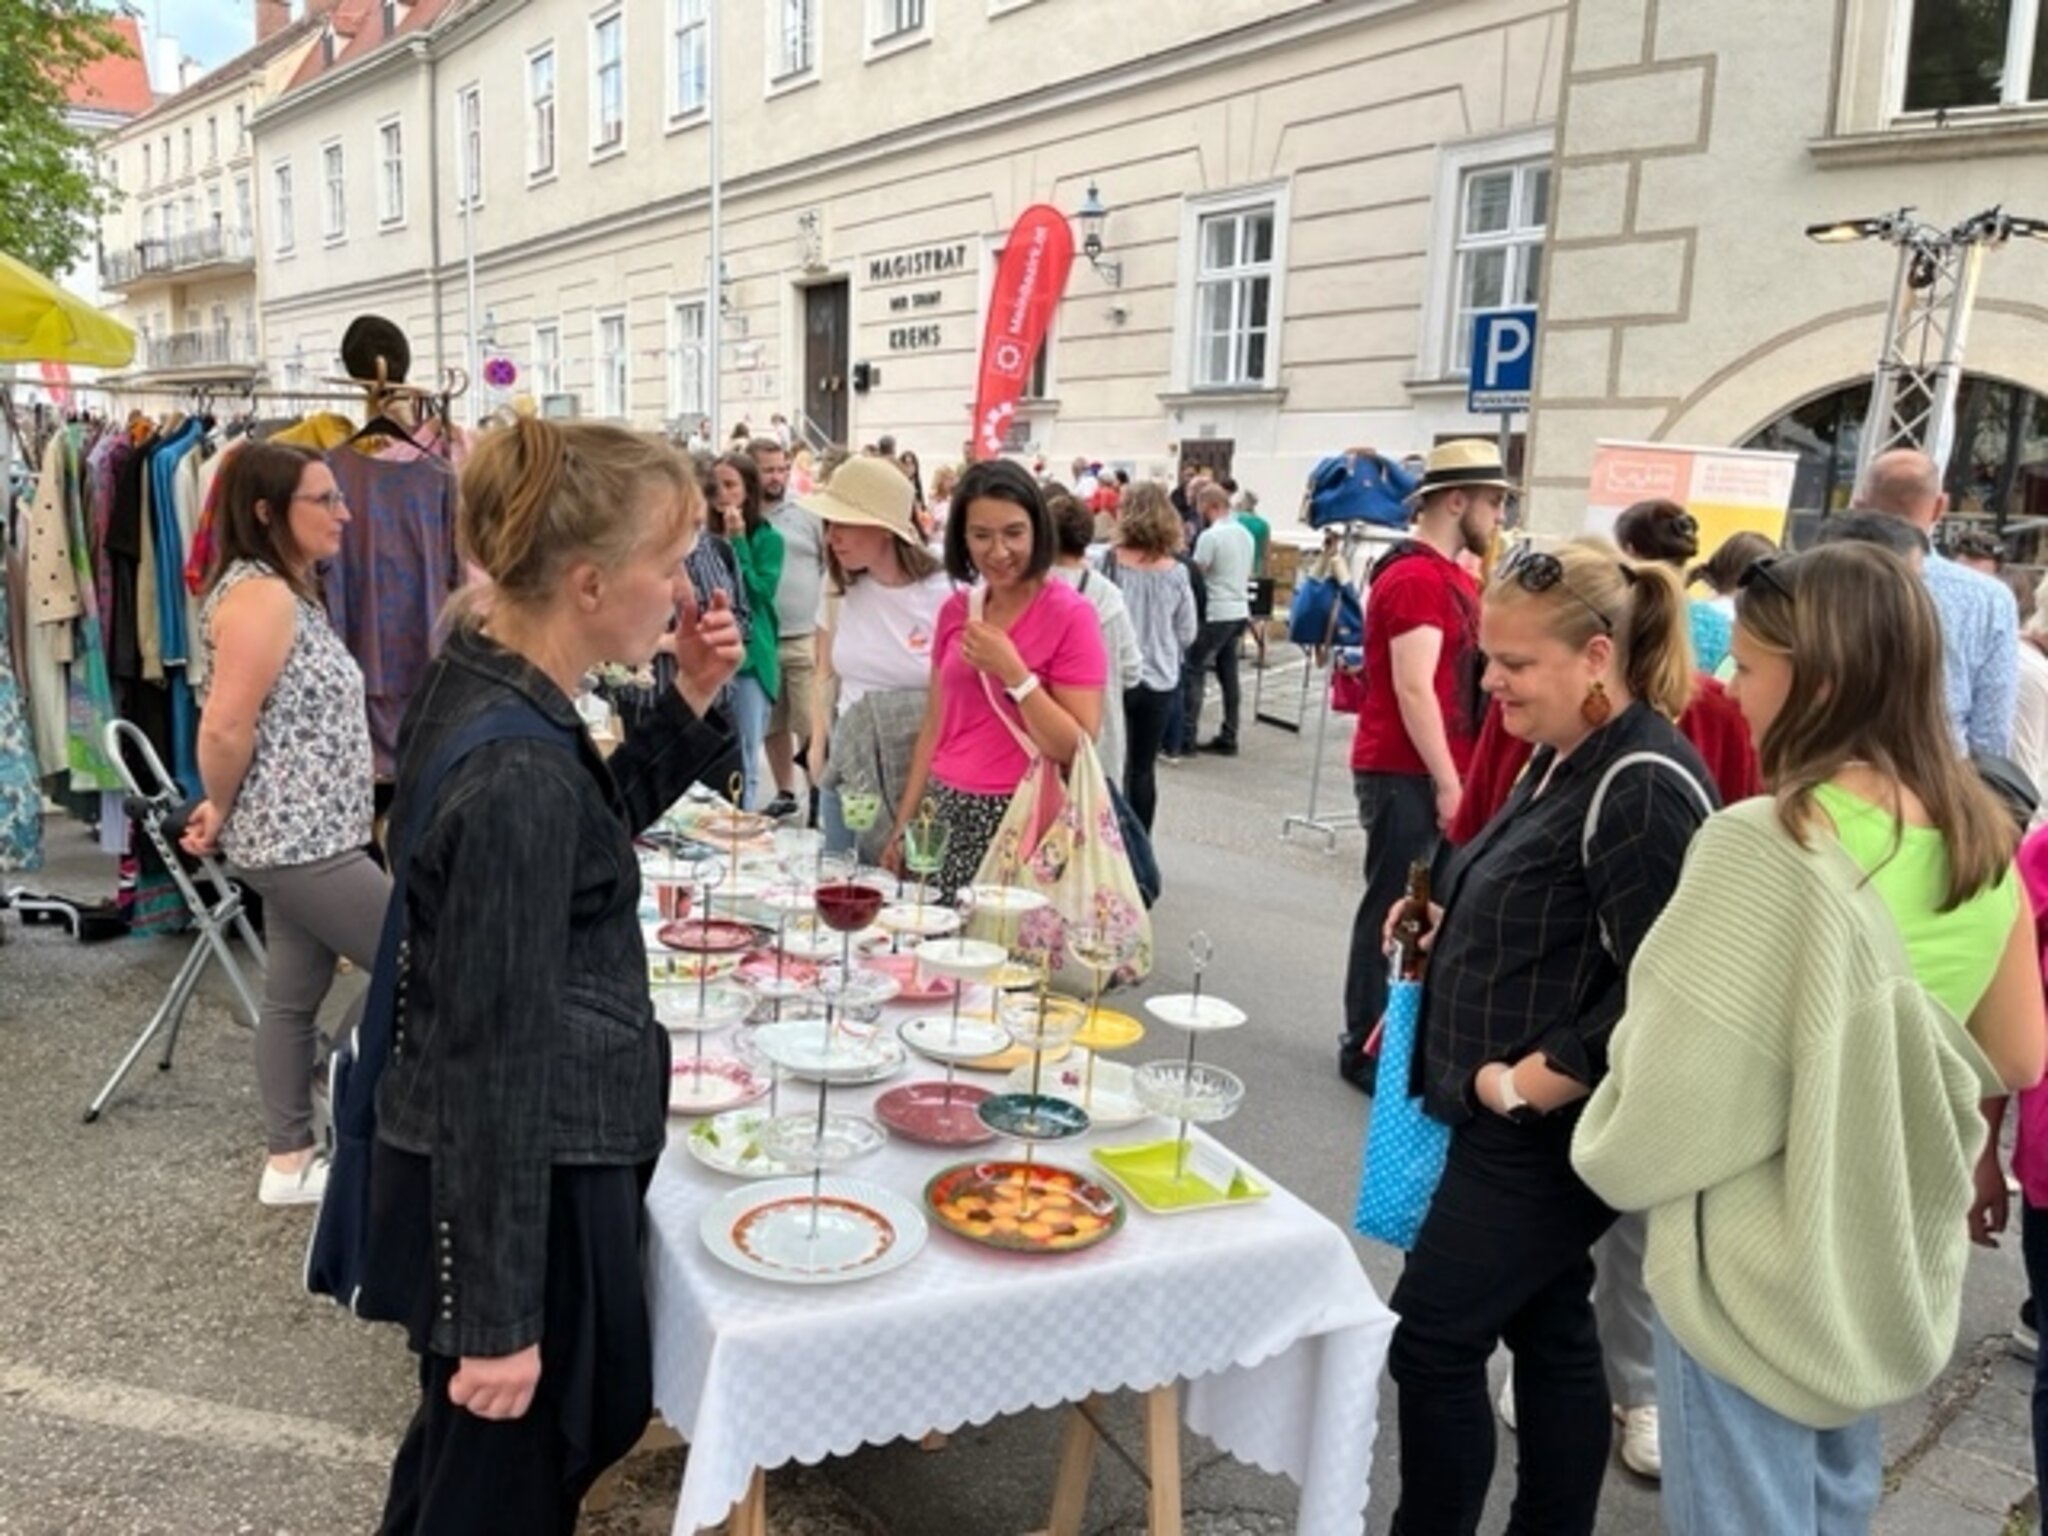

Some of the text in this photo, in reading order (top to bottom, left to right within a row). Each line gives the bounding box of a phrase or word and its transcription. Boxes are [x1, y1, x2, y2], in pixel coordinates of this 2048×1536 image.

[869, 244, 966, 281] MAGISTRAT
[889, 323, 941, 350] KREMS
[1484, 318, 1531, 387] P
